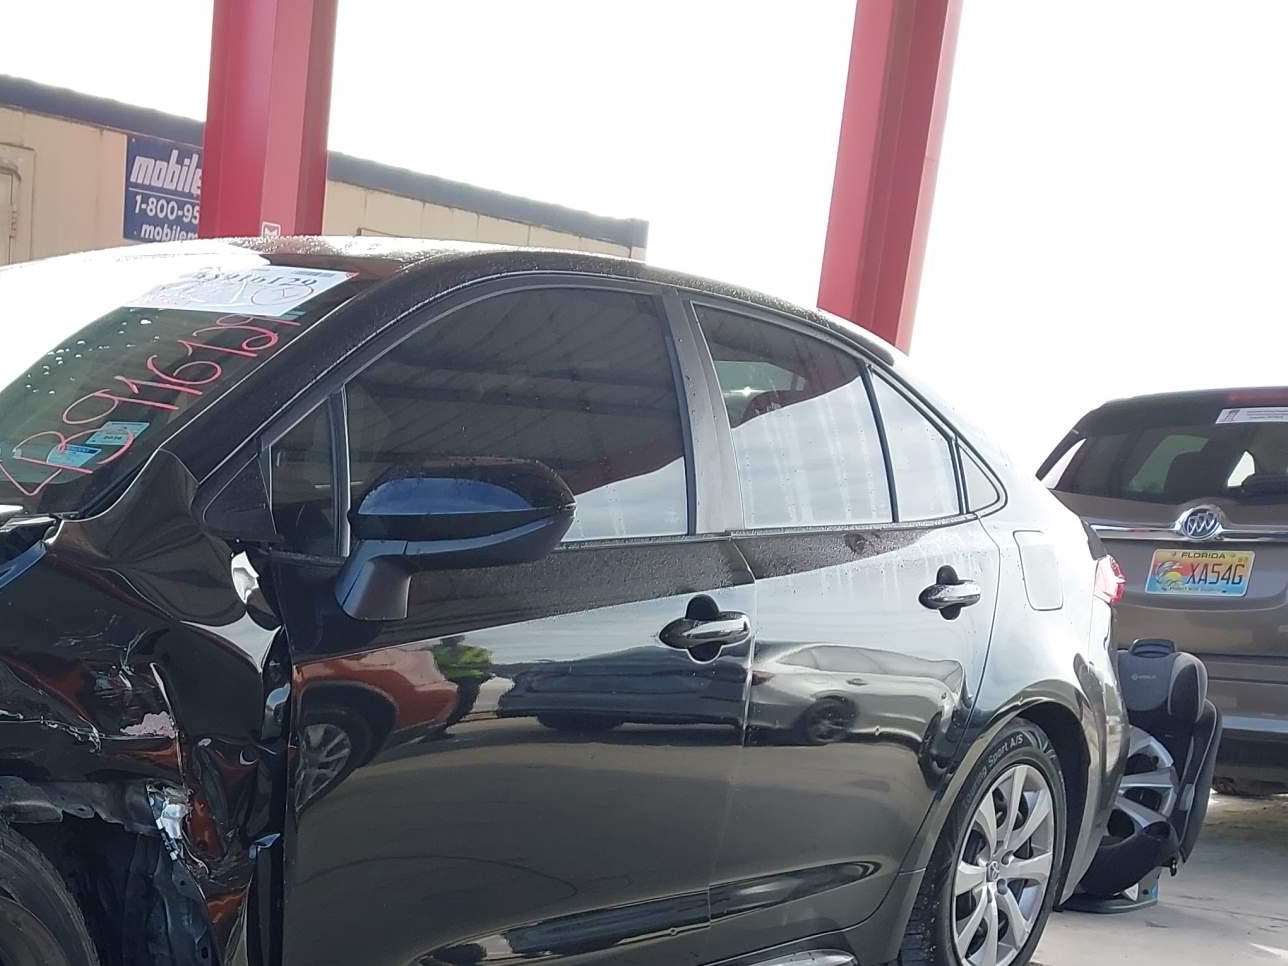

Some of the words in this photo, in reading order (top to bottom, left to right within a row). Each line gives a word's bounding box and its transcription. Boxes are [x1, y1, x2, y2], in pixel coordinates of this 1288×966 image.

[1180, 551, 1226, 559] FLORIDA
[1186, 562, 1245, 585] XA54G
[988, 741, 1009, 768] Sport
[1009, 733, 1024, 748] A/S
